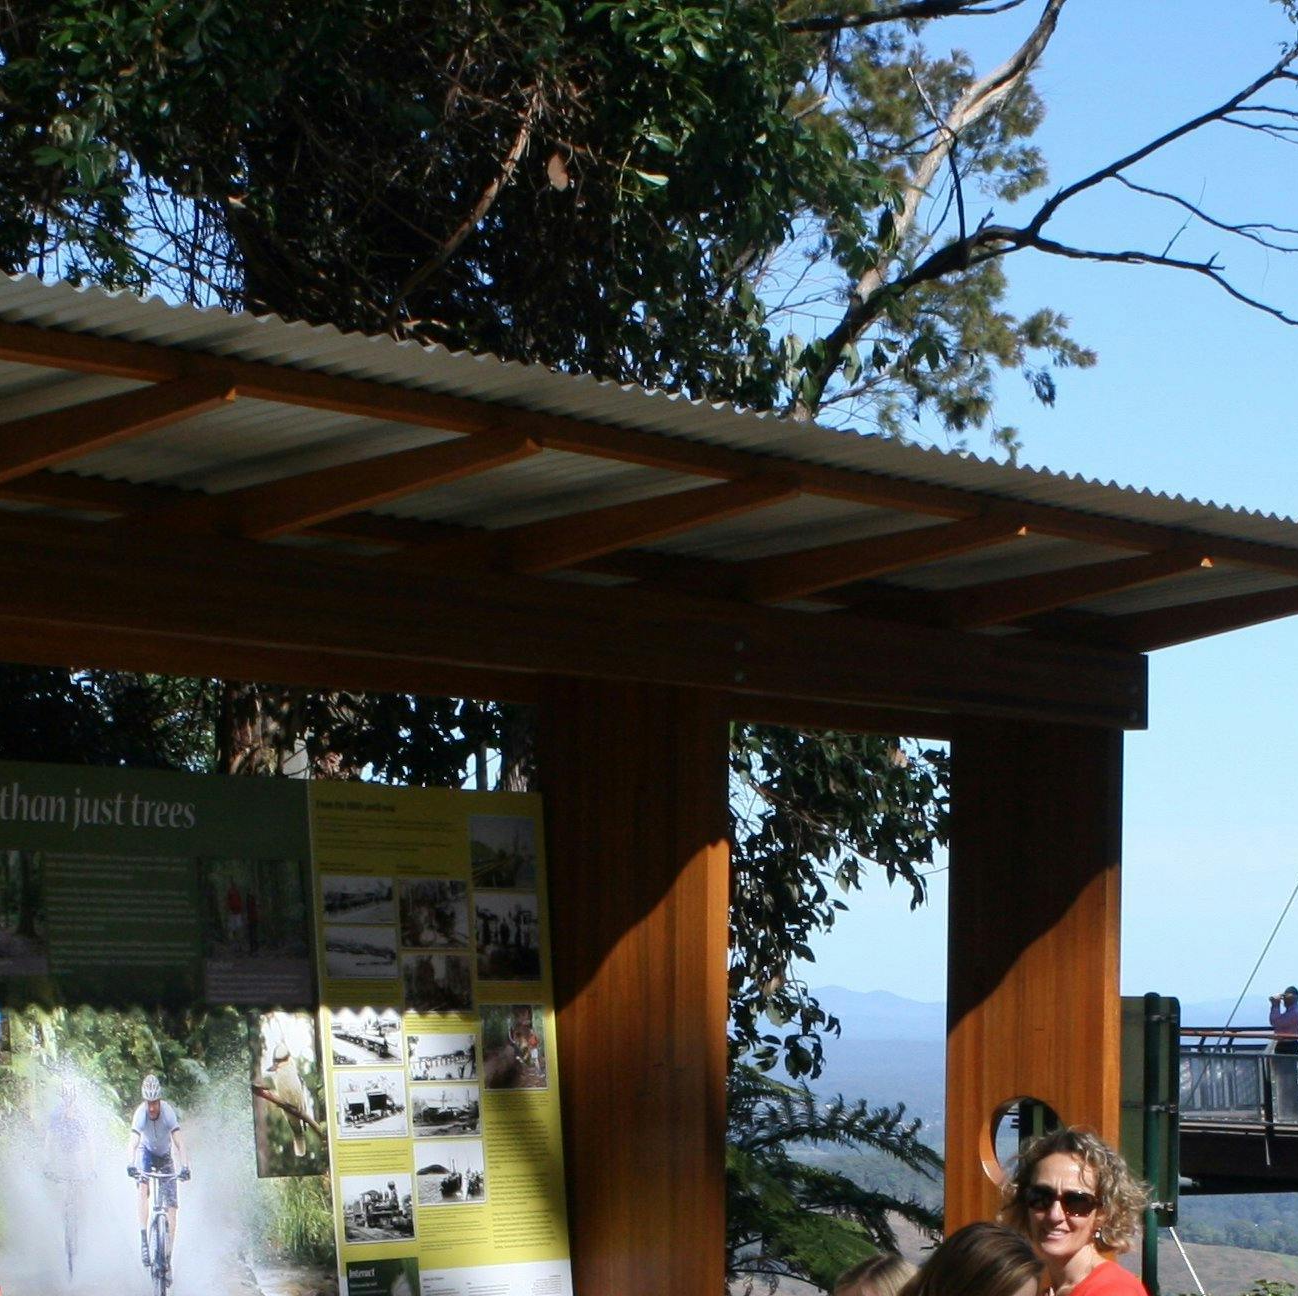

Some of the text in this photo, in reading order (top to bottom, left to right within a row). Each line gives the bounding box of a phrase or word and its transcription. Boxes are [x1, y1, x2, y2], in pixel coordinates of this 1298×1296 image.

[0, 782, 67, 822] than
[71, 786, 126, 832] just
[131, 792, 198, 829] trees
